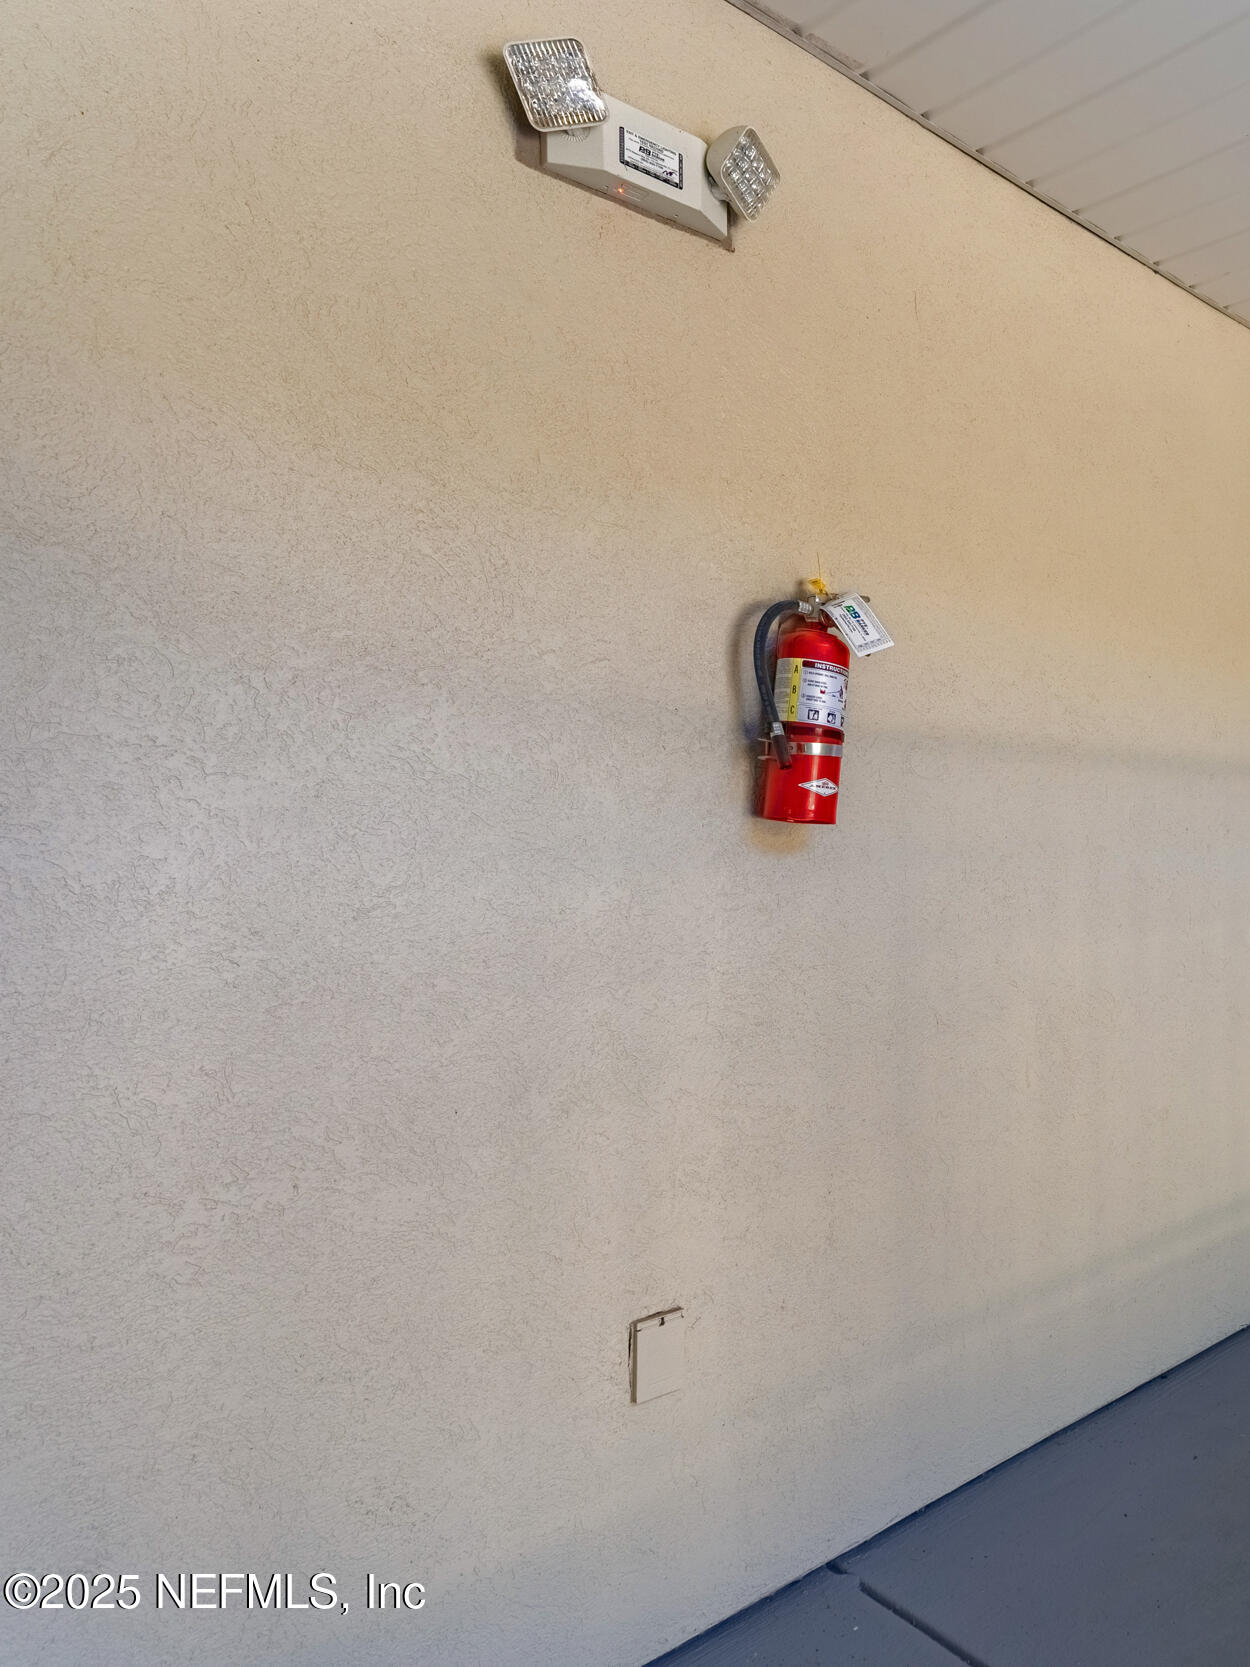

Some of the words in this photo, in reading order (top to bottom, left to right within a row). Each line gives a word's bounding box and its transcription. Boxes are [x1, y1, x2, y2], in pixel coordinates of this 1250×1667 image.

[793, 664, 799, 674] A
[791, 684, 797, 694] B
[789, 704, 795, 714] C
